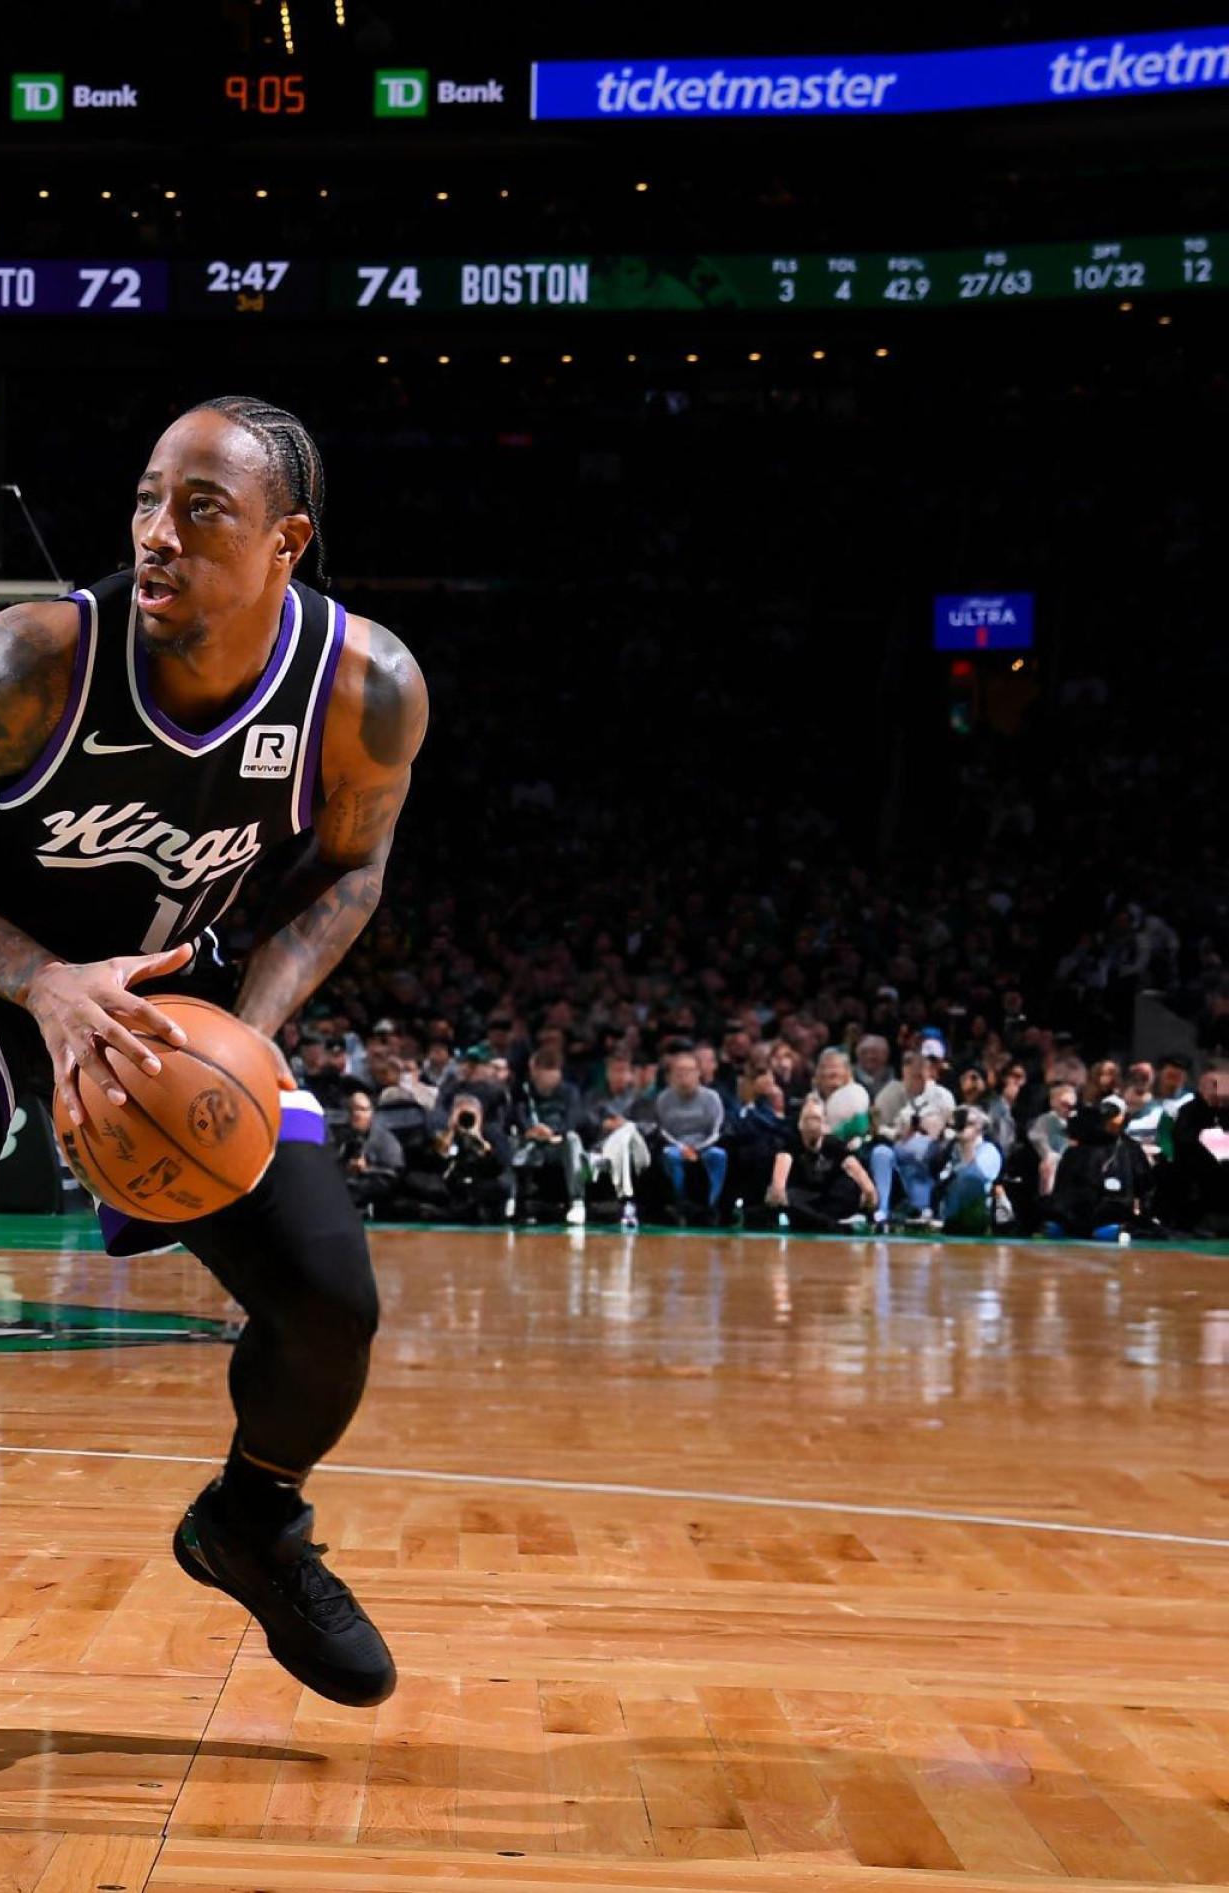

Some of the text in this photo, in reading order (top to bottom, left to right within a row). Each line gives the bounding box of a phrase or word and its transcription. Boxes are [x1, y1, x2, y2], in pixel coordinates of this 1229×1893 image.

[17, 82, 137, 112] TD Bank
[381, 77, 503, 108] TD Bank
[597, 65, 897, 112] ticketmaster
[78, 267, 141, 308] 72
[207, 261, 290, 292] 2:47
[357, 263, 588, 307] 74 BOSTON
[779, 278, 795, 303] 3
[835, 280, 851, 300] 4
[959, 270, 1032, 298] 27/63
[1073, 262, 1145, 290] 10/32
[1183, 257, 1212, 283] 12
[947, 607, 1018, 627] ULTRA
[254, 732, 286, 759] R
[243, 764, 288, 773] REVIVER
[35, 801, 263, 890] Kings
